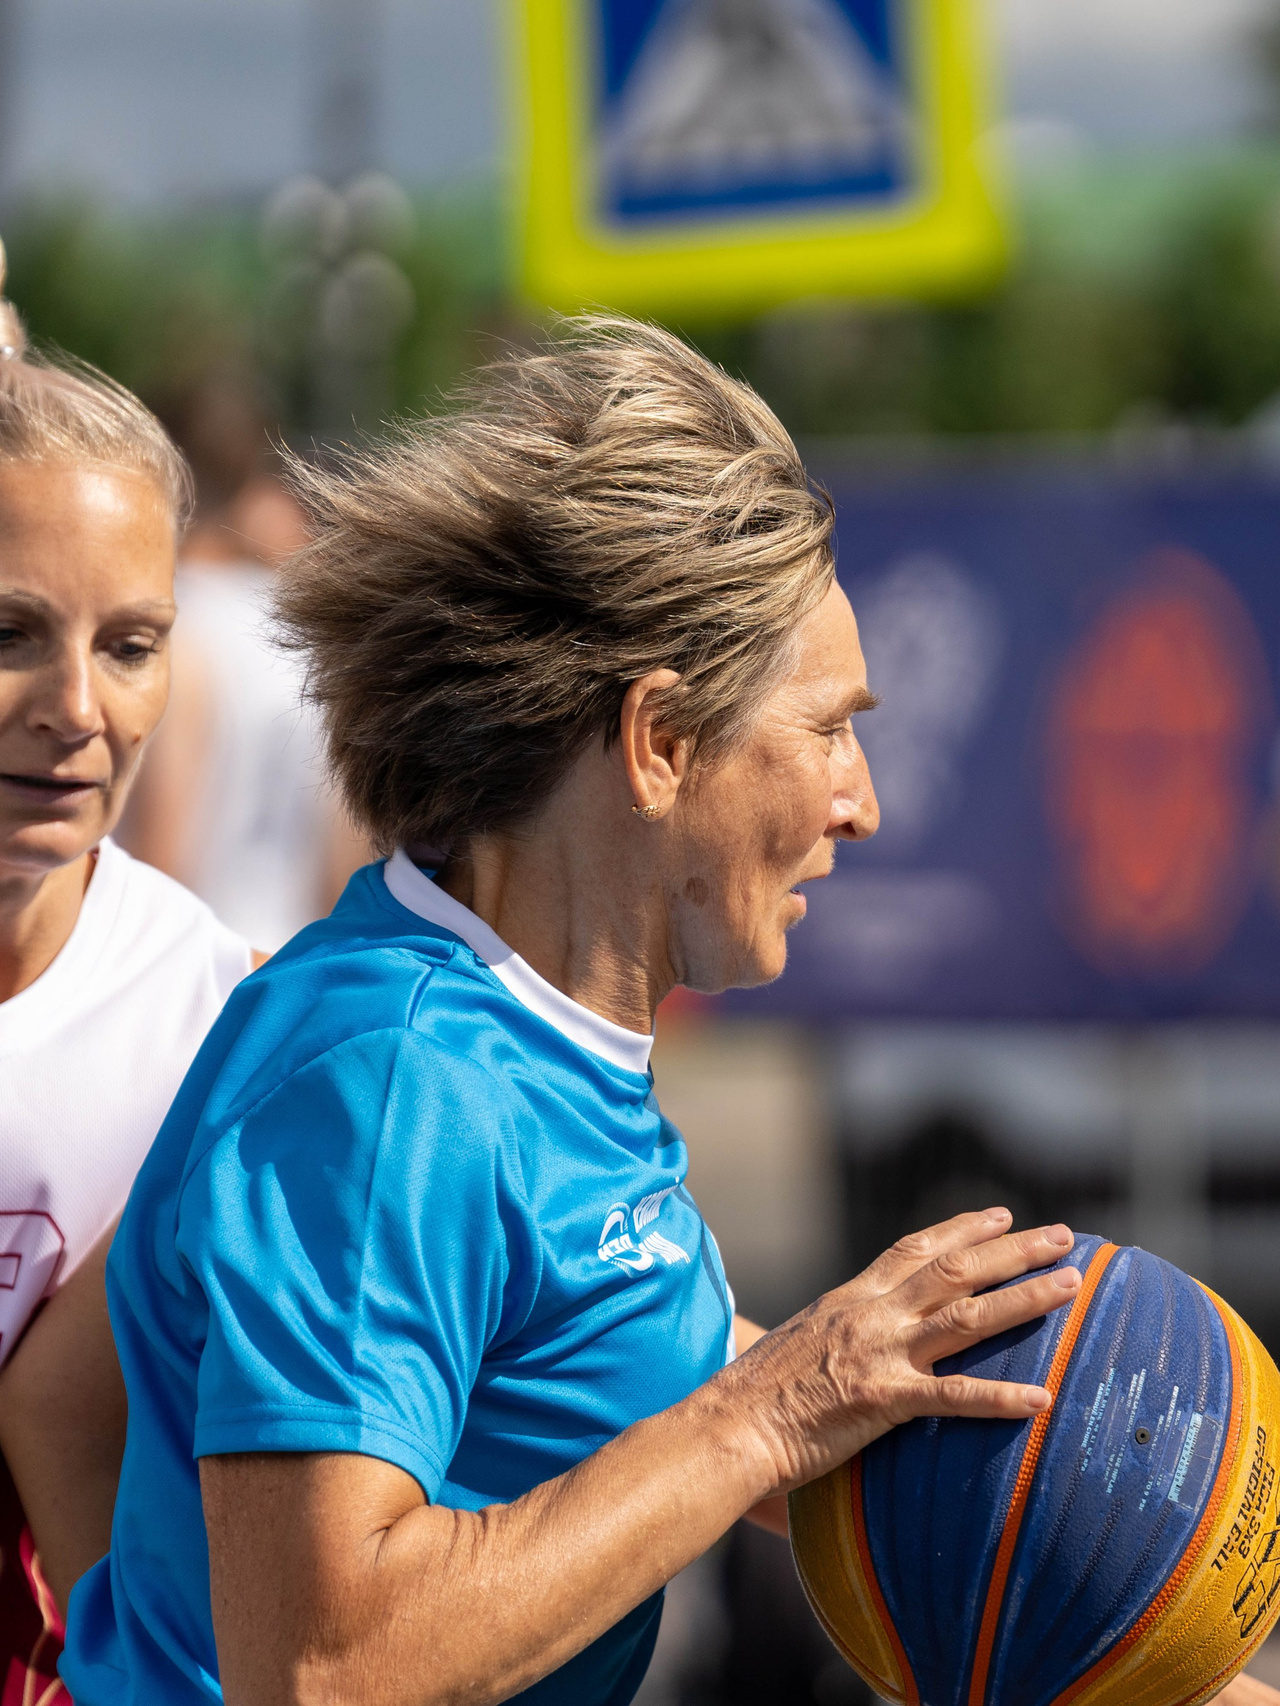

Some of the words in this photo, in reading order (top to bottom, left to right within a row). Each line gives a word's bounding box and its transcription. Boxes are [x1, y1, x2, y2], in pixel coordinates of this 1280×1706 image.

[1087, 1416, 1095, 1427] EN
[1080, 1426, 1091, 1448] CHINE
[1114, 1457, 1121, 1466] DE
[1105, 1467, 1118, 1494] INFLAR
[1237, 1425, 1267, 1521] OFFICIAL
[1144, 1480, 1152, 1490] TO
